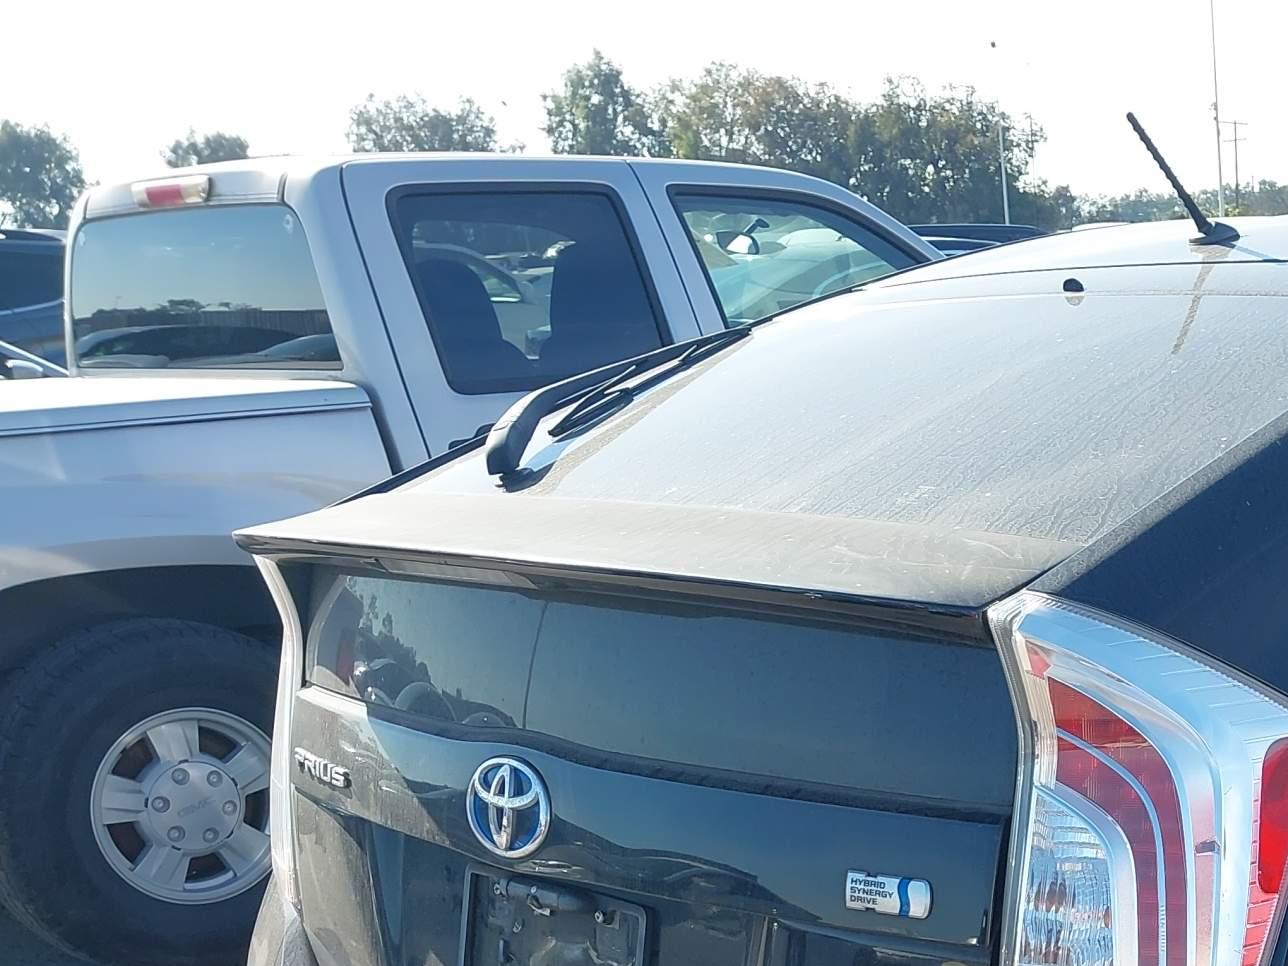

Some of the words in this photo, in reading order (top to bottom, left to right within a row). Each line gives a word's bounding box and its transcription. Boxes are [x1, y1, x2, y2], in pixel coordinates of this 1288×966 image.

[294, 747, 350, 788] PRIUS
[850, 877, 886, 889] HYBRID
[850, 886, 894, 899] SYNERGY
[849, 895, 878, 905] DRIVE
